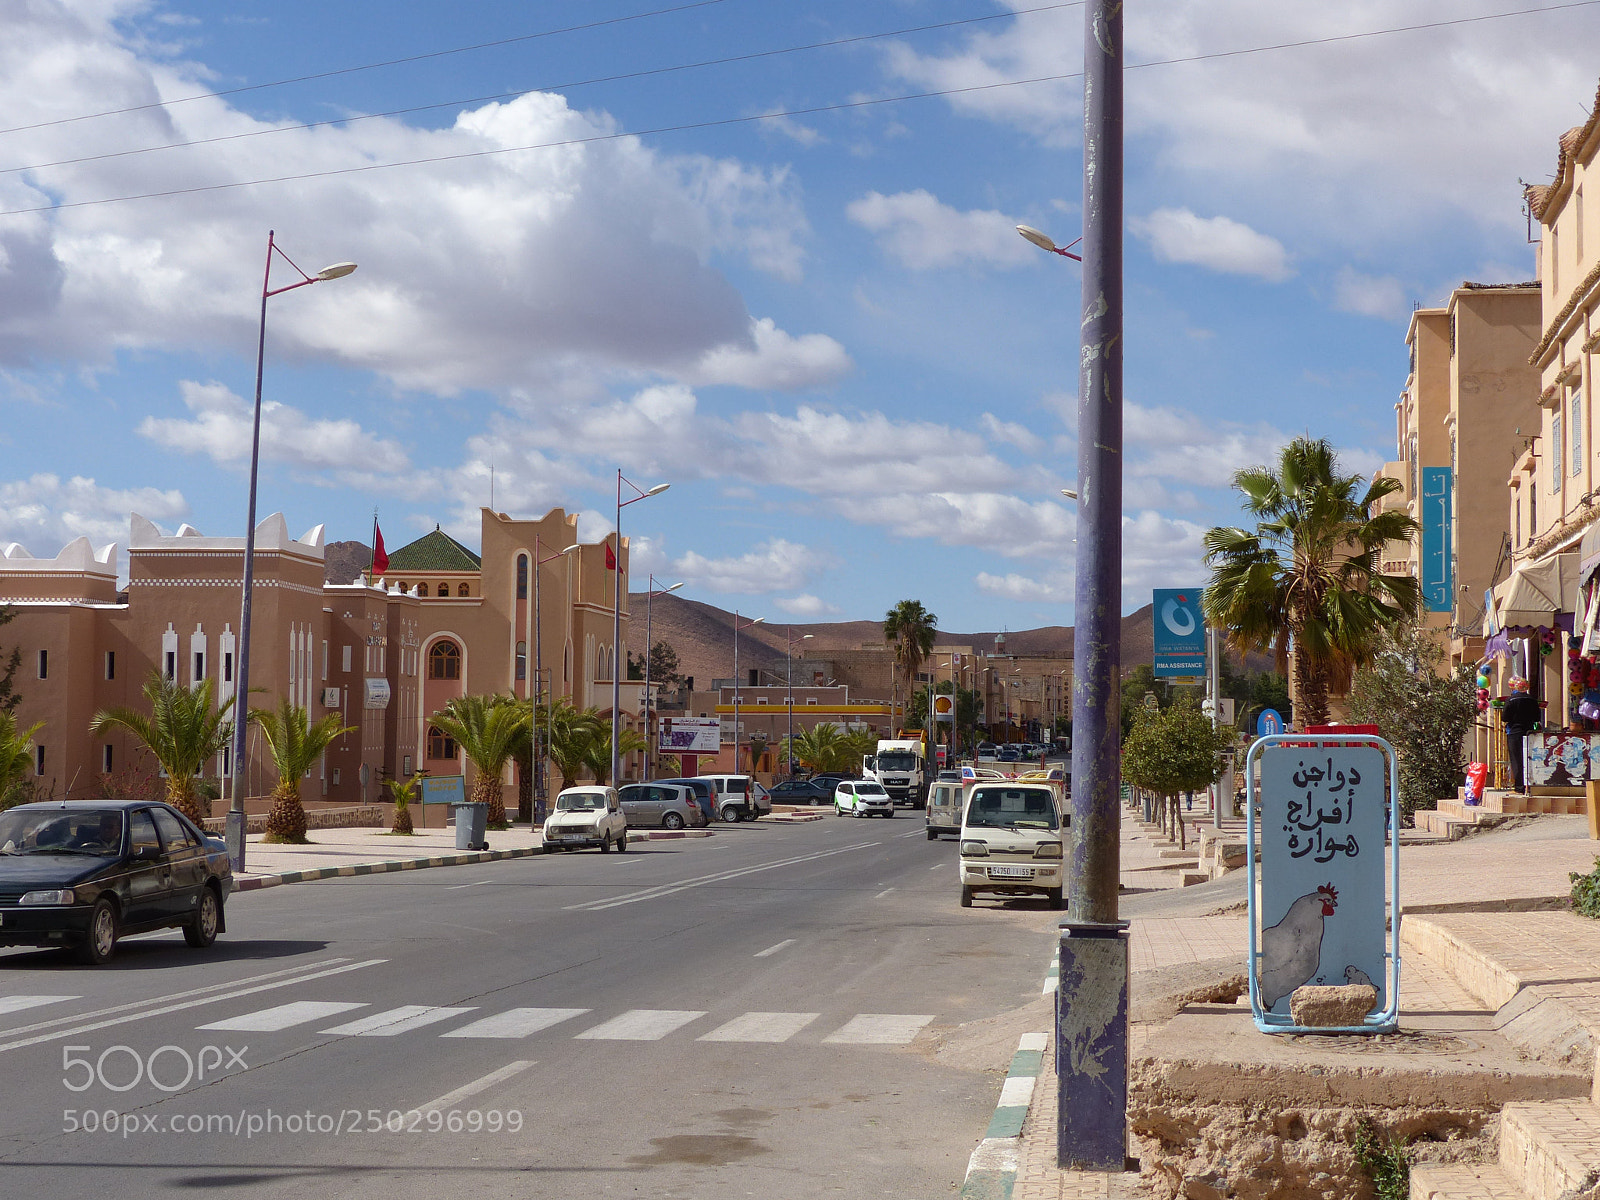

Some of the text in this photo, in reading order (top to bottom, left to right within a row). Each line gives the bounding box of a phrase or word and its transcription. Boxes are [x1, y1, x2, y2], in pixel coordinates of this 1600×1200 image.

[1424, 474, 1450, 605] تأمينات
[1292, 757, 1361, 792] دواجن
[1282, 825, 1360, 863] هوارة
